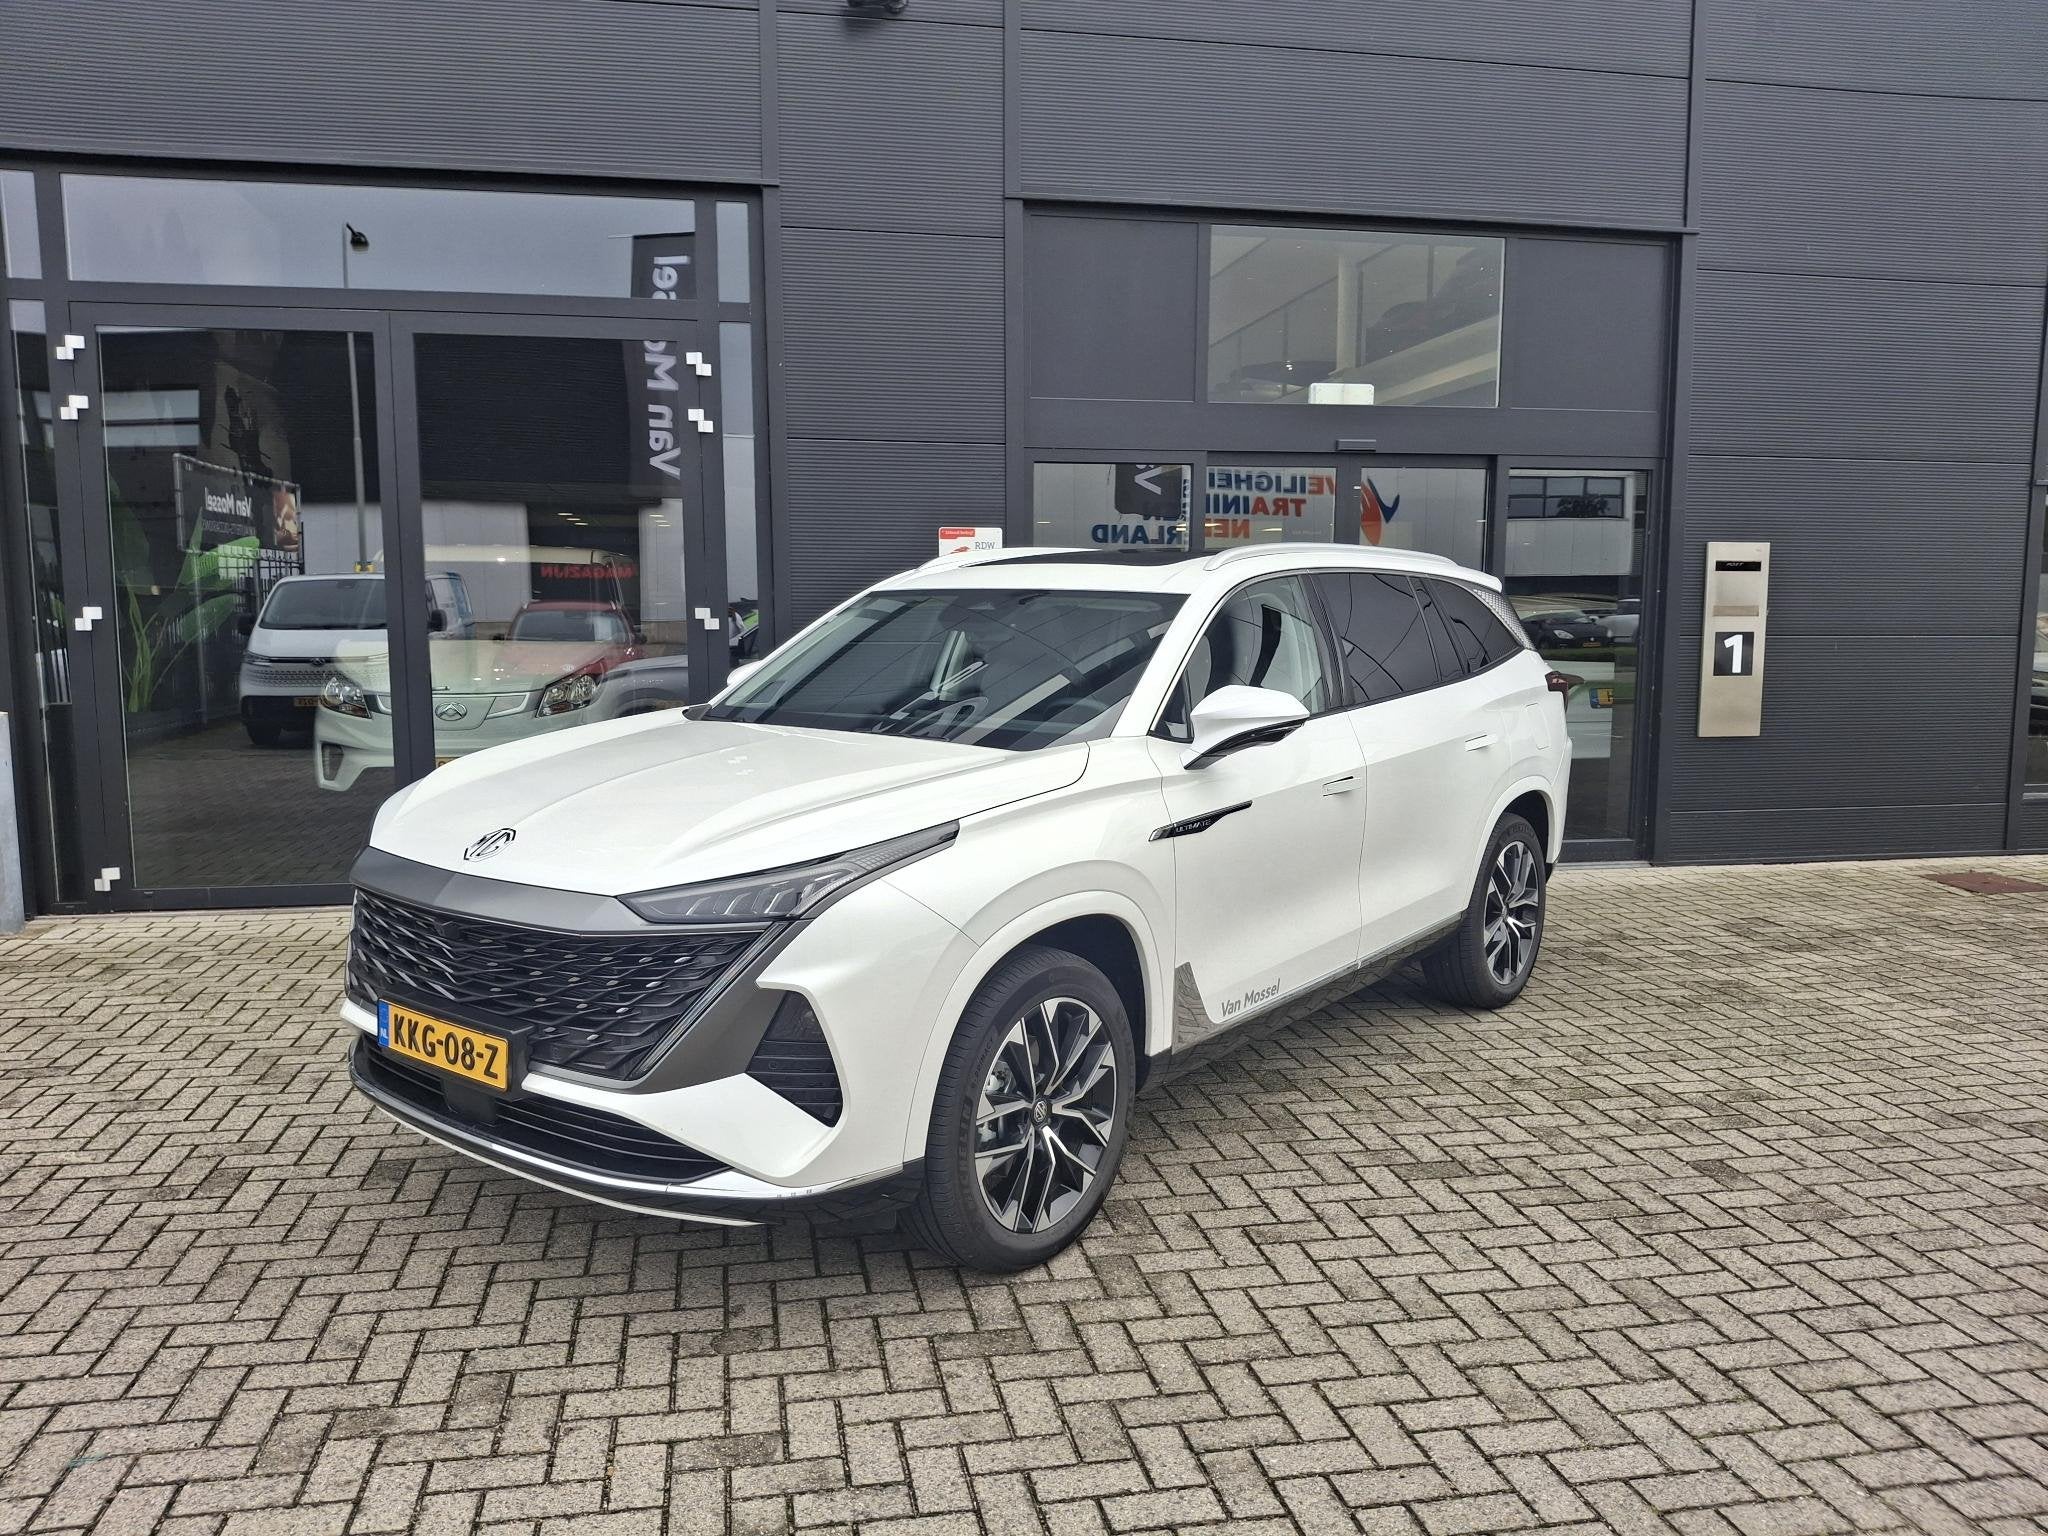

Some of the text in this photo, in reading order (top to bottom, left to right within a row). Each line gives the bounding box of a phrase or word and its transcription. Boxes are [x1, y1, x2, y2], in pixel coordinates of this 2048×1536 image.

[974, 541, 996, 550] RDW
[1723, 634, 1743, 673] 1
[467, 830, 513, 859] MG
[1221, 977, 1281, 1017] Van Mossel
[393, 1013, 499, 1080] KKG-08-Z
